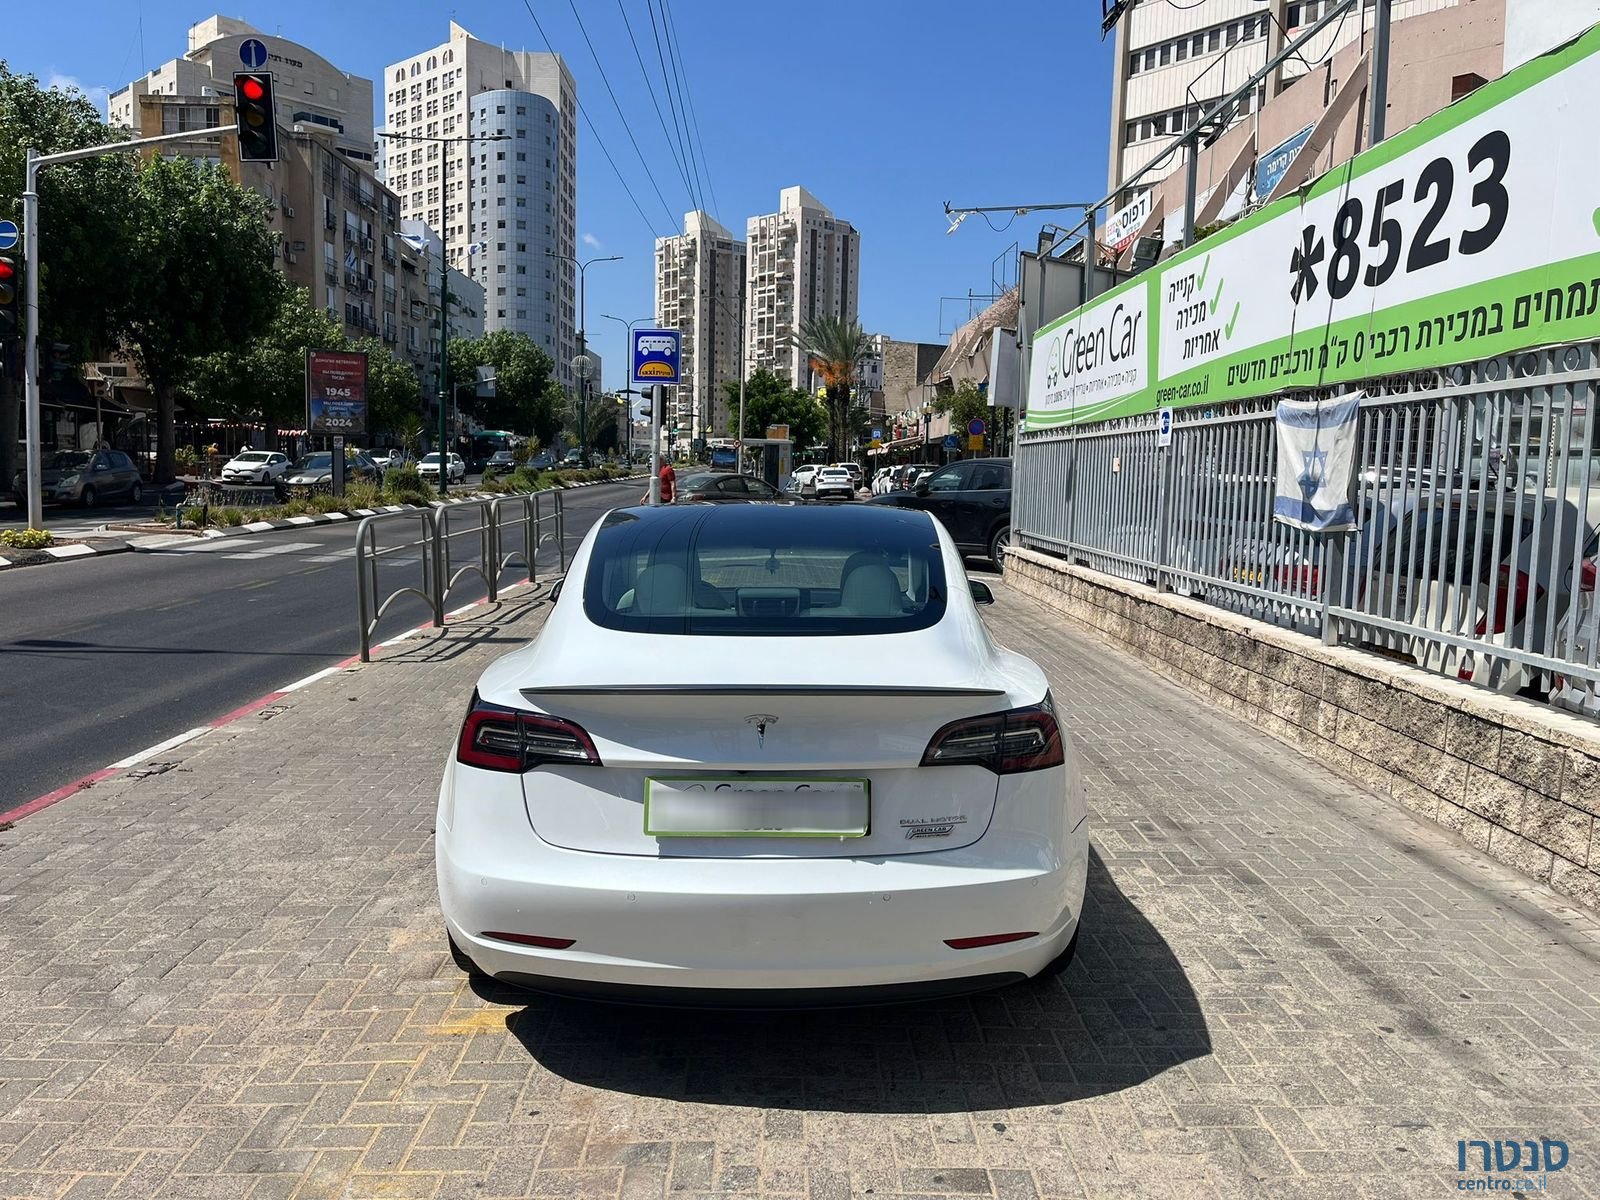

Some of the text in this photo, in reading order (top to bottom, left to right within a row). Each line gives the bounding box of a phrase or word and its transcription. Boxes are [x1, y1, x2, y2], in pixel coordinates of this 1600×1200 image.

[1122, 199, 1146, 229] דפוס
[1168, 273, 1195, 303] קנייה
[1176, 300, 1207, 331] מכירה
[1415, 302, 1504, 351] במכירת
[1062, 303, 1142, 378] Green Car
[1183, 328, 1221, 360] אחריות
[1353, 331, 1365, 363] 0
[1370, 325, 1410, 359] רכבי
[1227, 358, 1266, 387] חדשים
[1269, 347, 1315, 378] ורכבים
[325, 387, 351, 397] 1945
[1156, 374, 1209, 407] green-car.co.il
[325, 418, 353, 428] 2024
